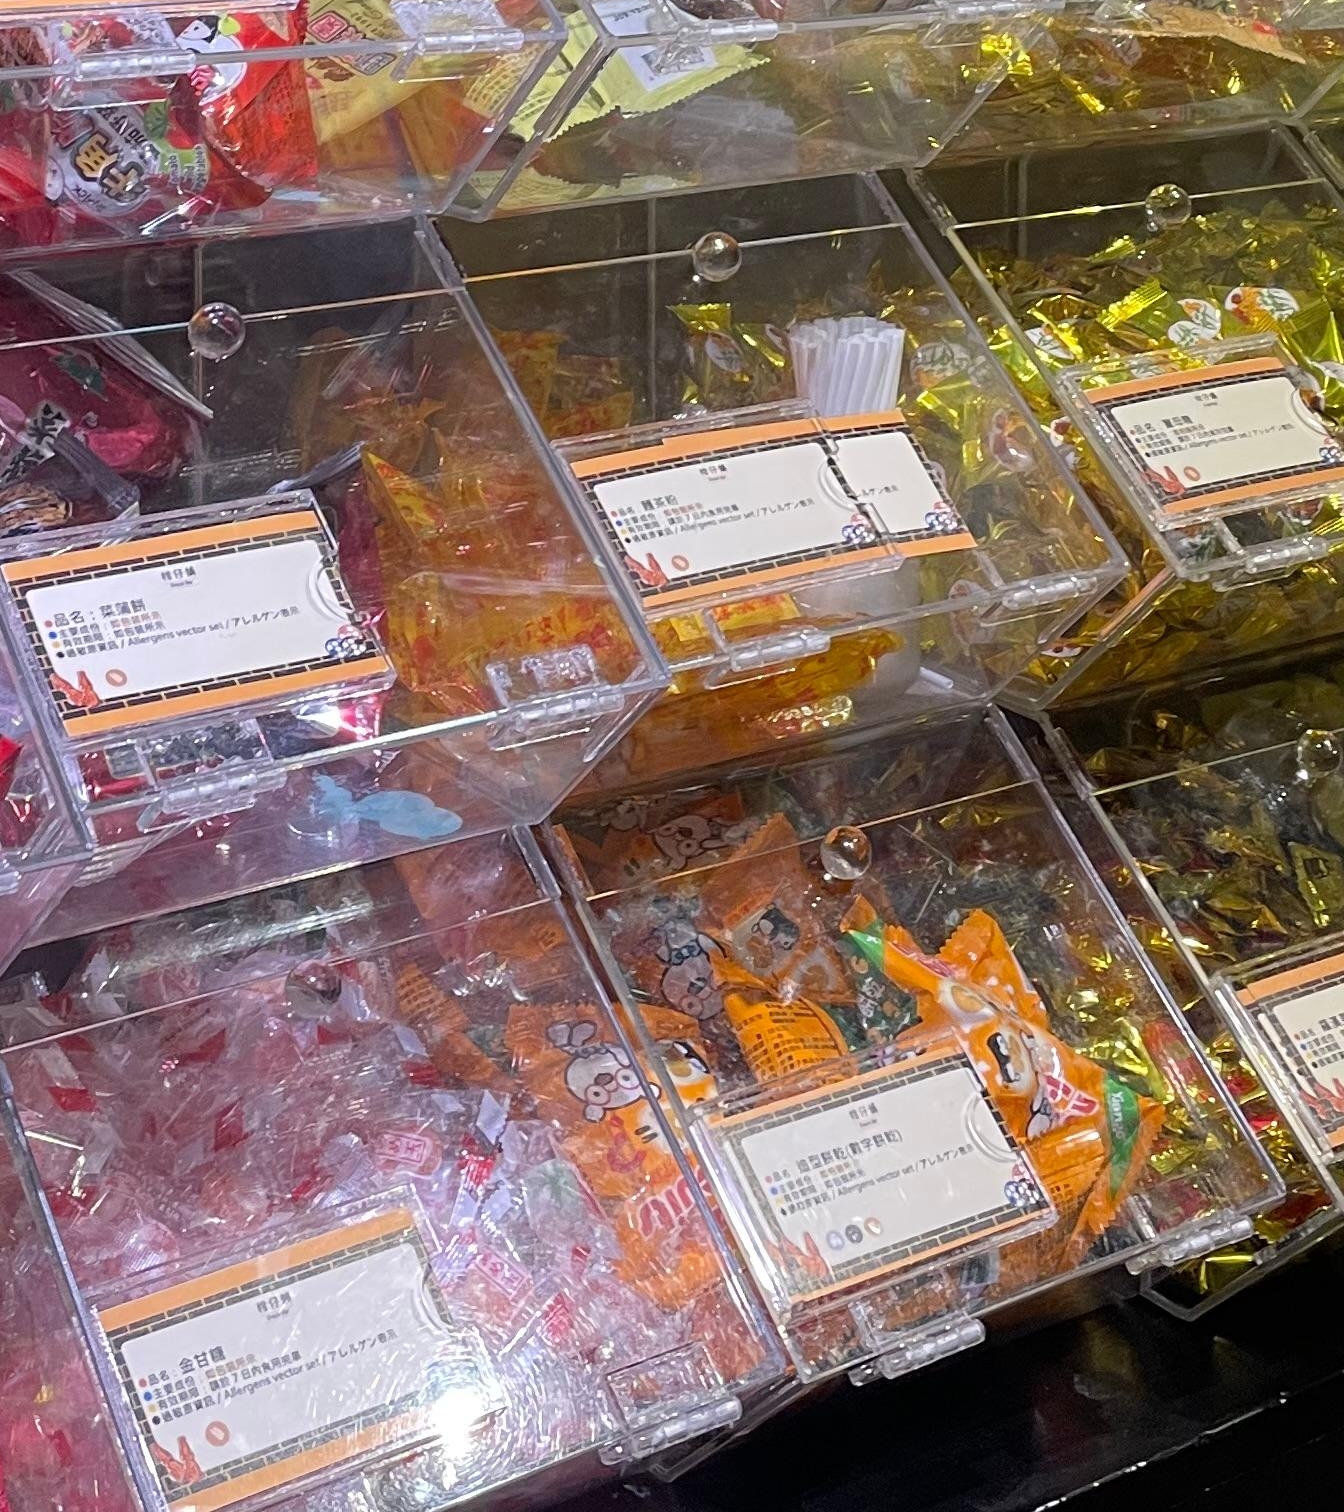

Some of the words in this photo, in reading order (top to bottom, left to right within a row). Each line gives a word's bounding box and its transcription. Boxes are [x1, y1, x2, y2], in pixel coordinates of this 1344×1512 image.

[125, 629, 176, 649] Allergens
[173, 624, 207, 638] vector
[206, 620, 224, 632] set
